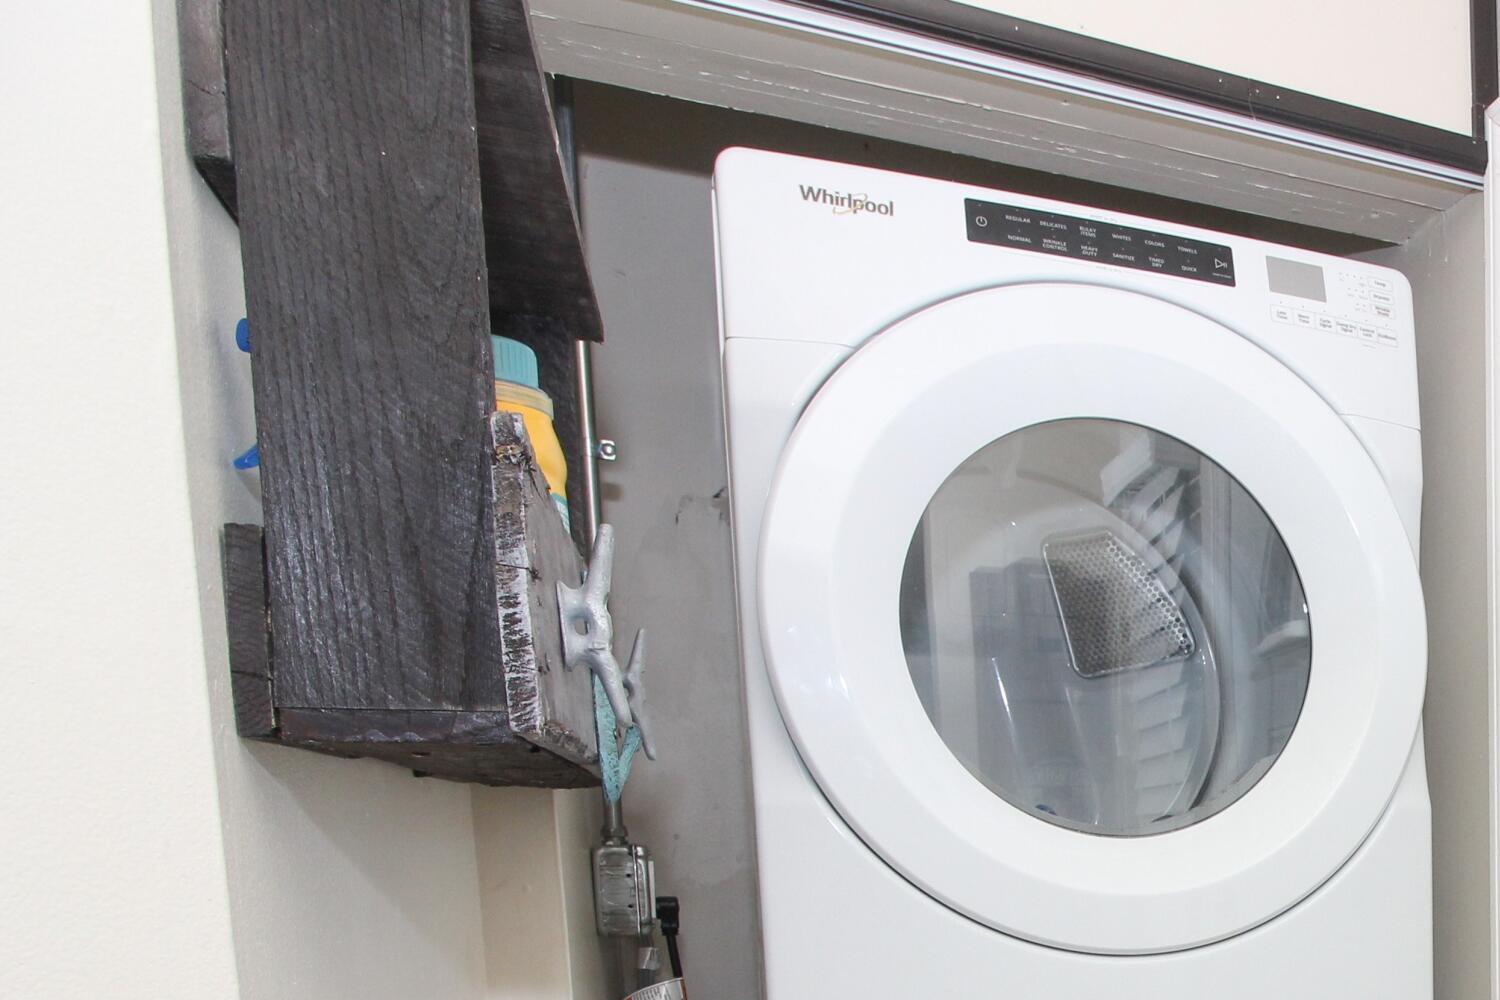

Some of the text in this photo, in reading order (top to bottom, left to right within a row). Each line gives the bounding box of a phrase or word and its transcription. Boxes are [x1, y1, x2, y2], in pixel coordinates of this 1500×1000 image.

[799, 184, 894, 216] Whirlpool
[1005, 214, 1031, 224] REGULAR
[1039, 220, 1068, 231] DELICATES
[1007, 234, 1032, 244] NORMAL
[1112, 233, 1132, 242] WHITES
[1144, 239, 1166, 249] COLORS
